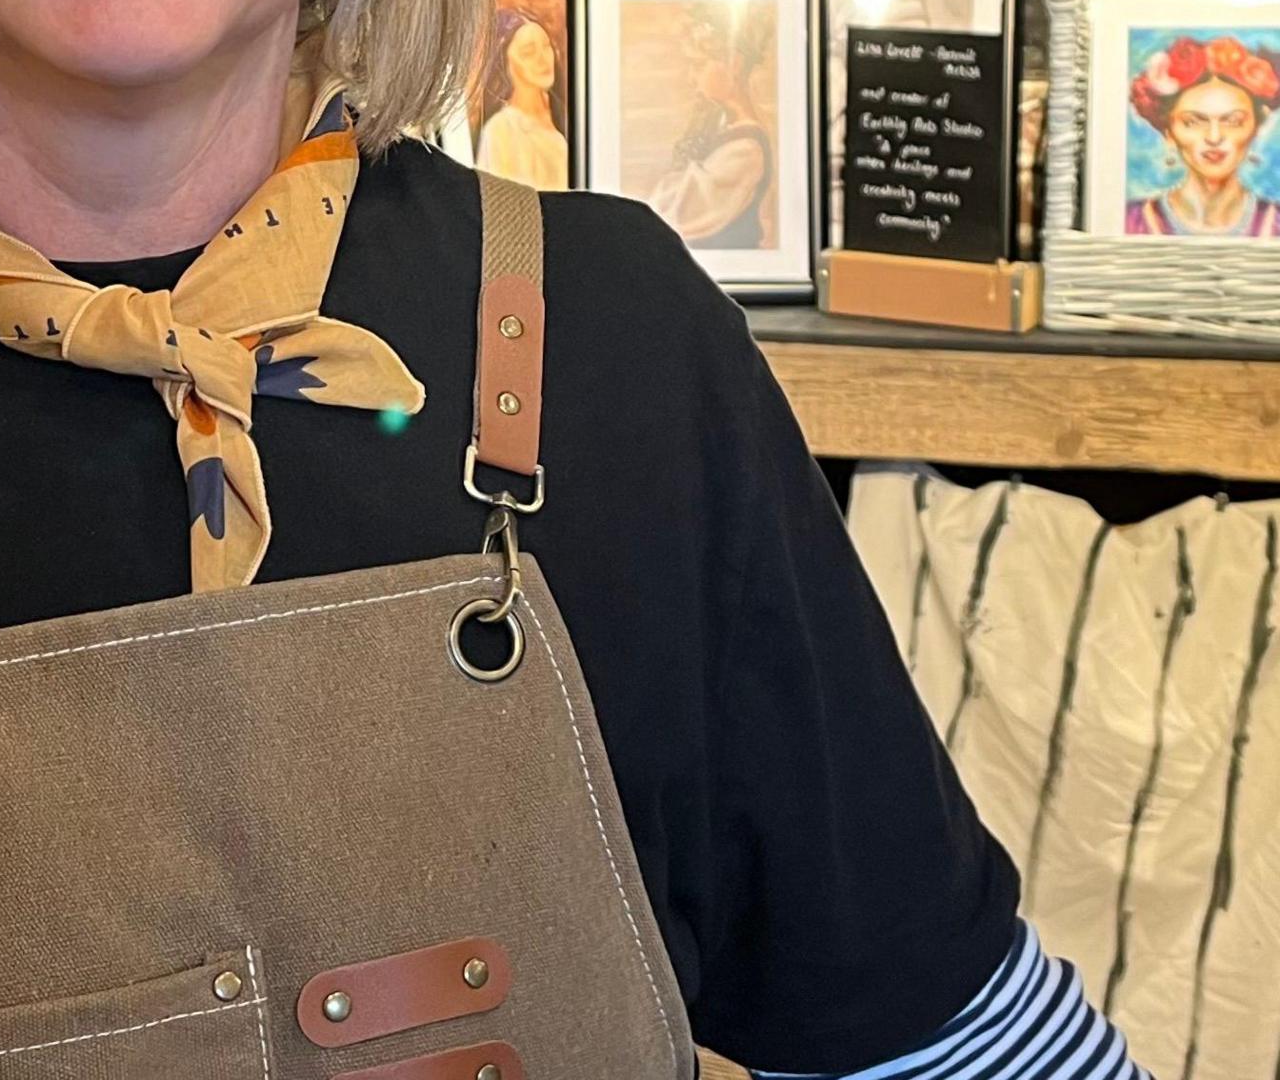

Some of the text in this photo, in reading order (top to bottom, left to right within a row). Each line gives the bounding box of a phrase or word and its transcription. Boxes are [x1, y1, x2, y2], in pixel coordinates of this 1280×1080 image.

[860, 112, 983, 141] Earthly Arts Studio
[946, 167, 972, 179] and
[863, 184, 915, 210] creativity
